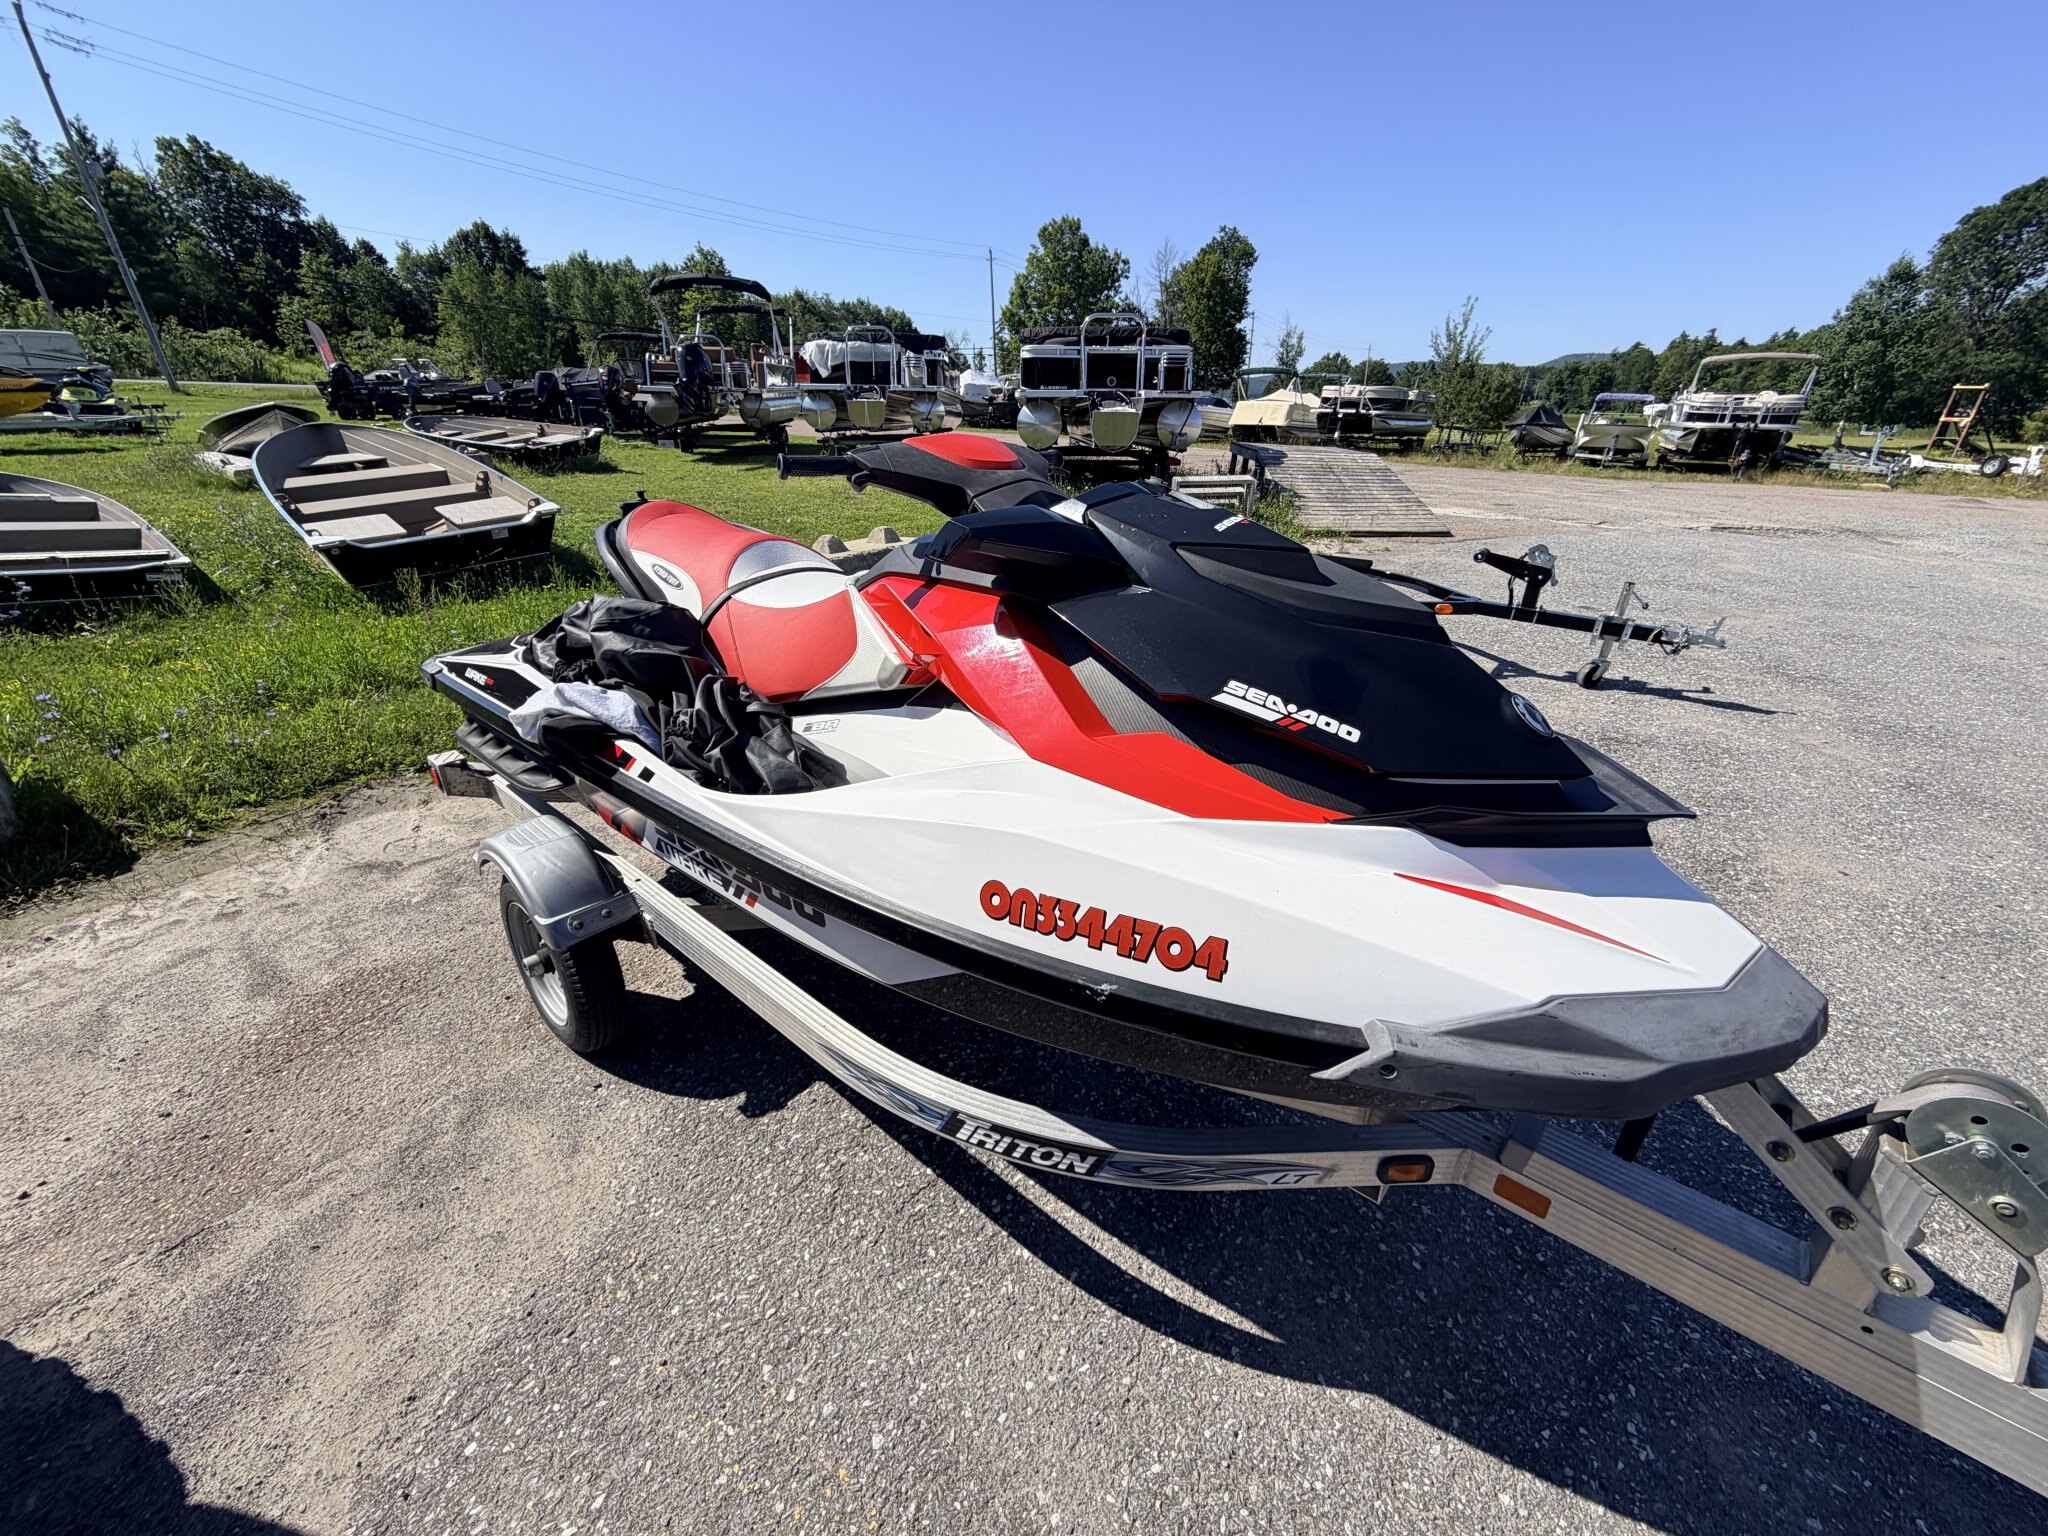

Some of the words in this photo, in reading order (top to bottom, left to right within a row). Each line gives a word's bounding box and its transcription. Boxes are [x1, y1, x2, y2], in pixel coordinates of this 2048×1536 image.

[464, 667, 487, 686] WAKE
[955, 1112, 1099, 1175] TRITON
[1270, 1172, 1320, 1185] LT
